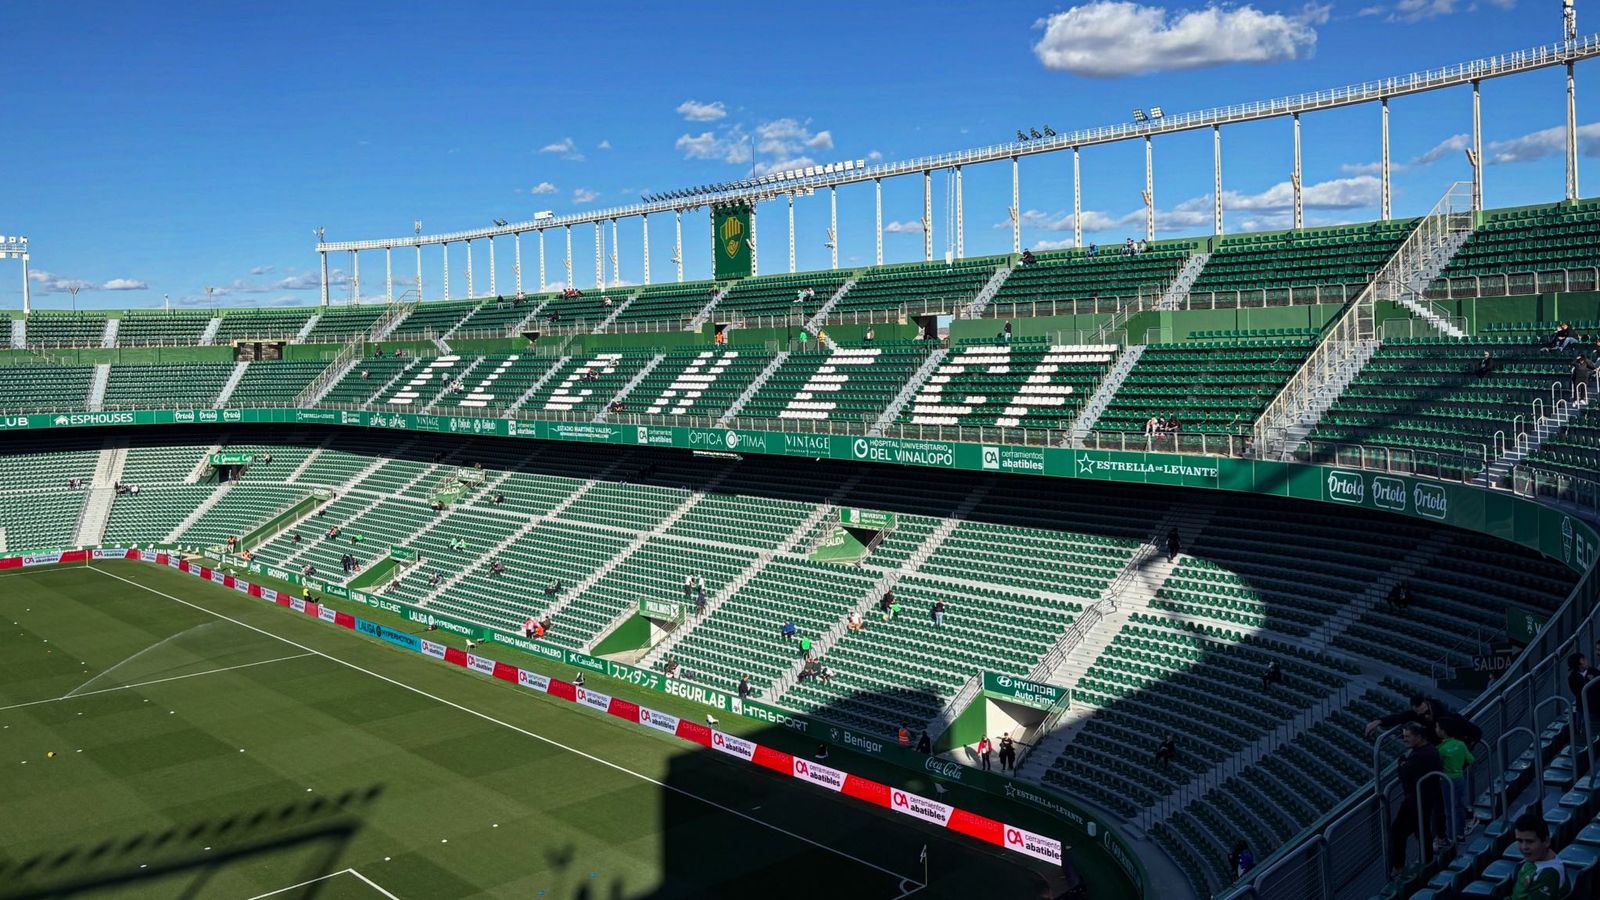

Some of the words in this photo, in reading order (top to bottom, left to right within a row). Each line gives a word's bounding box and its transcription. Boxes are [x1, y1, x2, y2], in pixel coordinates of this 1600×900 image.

[70, 413, 133, 424] ESPHOUSES
[416, 416, 439, 426] VINTAGE
[649, 435, 672, 443] abatibles
[785, 435, 829, 449] VINTAGE
[870, 440, 899, 448] HOSPITAL
[902, 442, 947, 451] UNIVERSITARIO
[870, 448, 892, 461] DEL
[895, 449, 953, 465] VINALOPÓ
[1001, 451, 1043, 460] cerramientos
[1002, 458, 1044, 470] abatibles
[1096, 461, 1154, 473] ESTRELLA
[1163, 465, 1218, 477] LEVANTE
[1327, 475, 1364, 496] Ortola
[1371, 481, 1406, 503] Ortola
[1413, 488, 1448, 512] Ortola
[860, 512, 887, 520] UNIVERSITAS
[826, 537, 845, 548] SALIDA
[358, 621, 376, 634] LALIGA
[409, 610, 428, 625] LALIGA
[434, 619, 471, 635] HYPERMOTION
[494, 633, 515, 645] ESTADIO
[515, 637, 541, 653] MARTÍNEZ
[541, 645, 562, 659] VALERO
[576, 655, 603, 670] CaixaBank
[1474, 655, 1512, 672] SALIDA
[665, 679, 726, 709] SEGURLAB
[1014, 680, 1056, 697] HYUNDAI
[1014, 690, 1033, 701] Auto
[587, 698, 608, 709] abatibles
[652, 718, 675, 731] abatibles
[725, 741, 752, 757] abatibles
[844, 731, 882, 753] Benigar
[809, 764, 841, 779] cerramientos
[809, 771, 841, 787] abatibles
[909, 796, 945, 813] cerramientos
[1016, 788, 1052, 809] ESTRELLA
[1056, 804, 1084, 825] LEVANTE
[910, 804, 946, 822] abatibles
